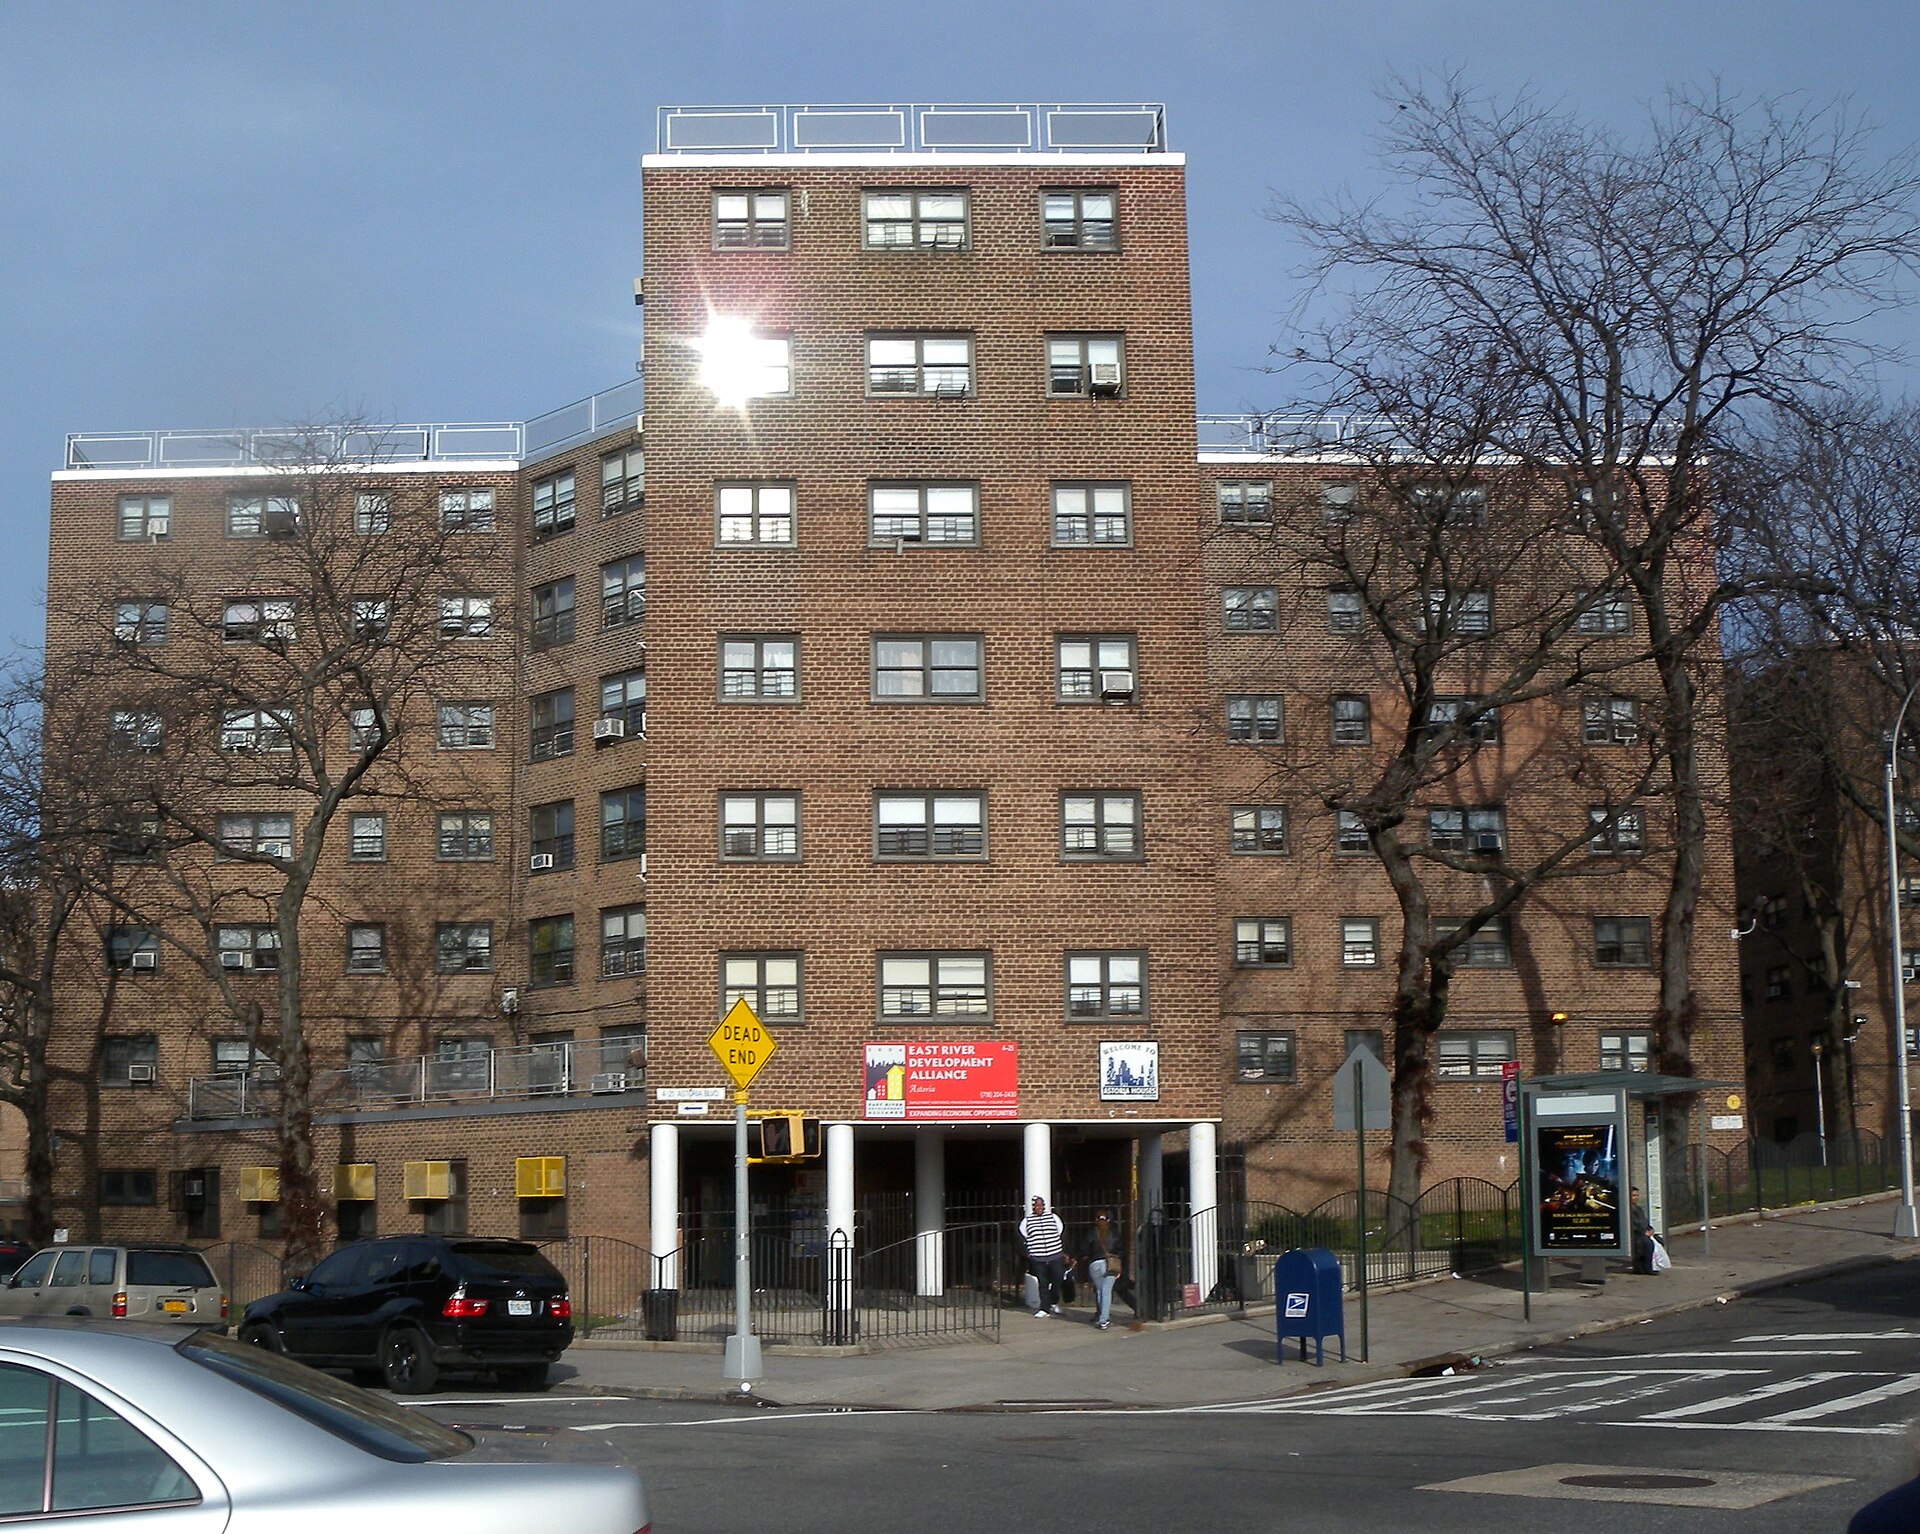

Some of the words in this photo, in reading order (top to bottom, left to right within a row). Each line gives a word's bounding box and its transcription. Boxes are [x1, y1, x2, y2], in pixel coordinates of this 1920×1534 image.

[723, 1025, 760, 1042] DEAD
[908, 1045, 939, 1056] EAST
[941, 1045, 976, 1055] RIVER
[1102, 1043, 1142, 1055] WELCOME
[1145, 1047, 1156, 1055] TO
[729, 1049, 756, 1065] END
[908, 1057, 994, 1068] DEVELOPMENT
[909, 1069, 968, 1080] ALLIANCE
[908, 1084, 936, 1093] Astoria
